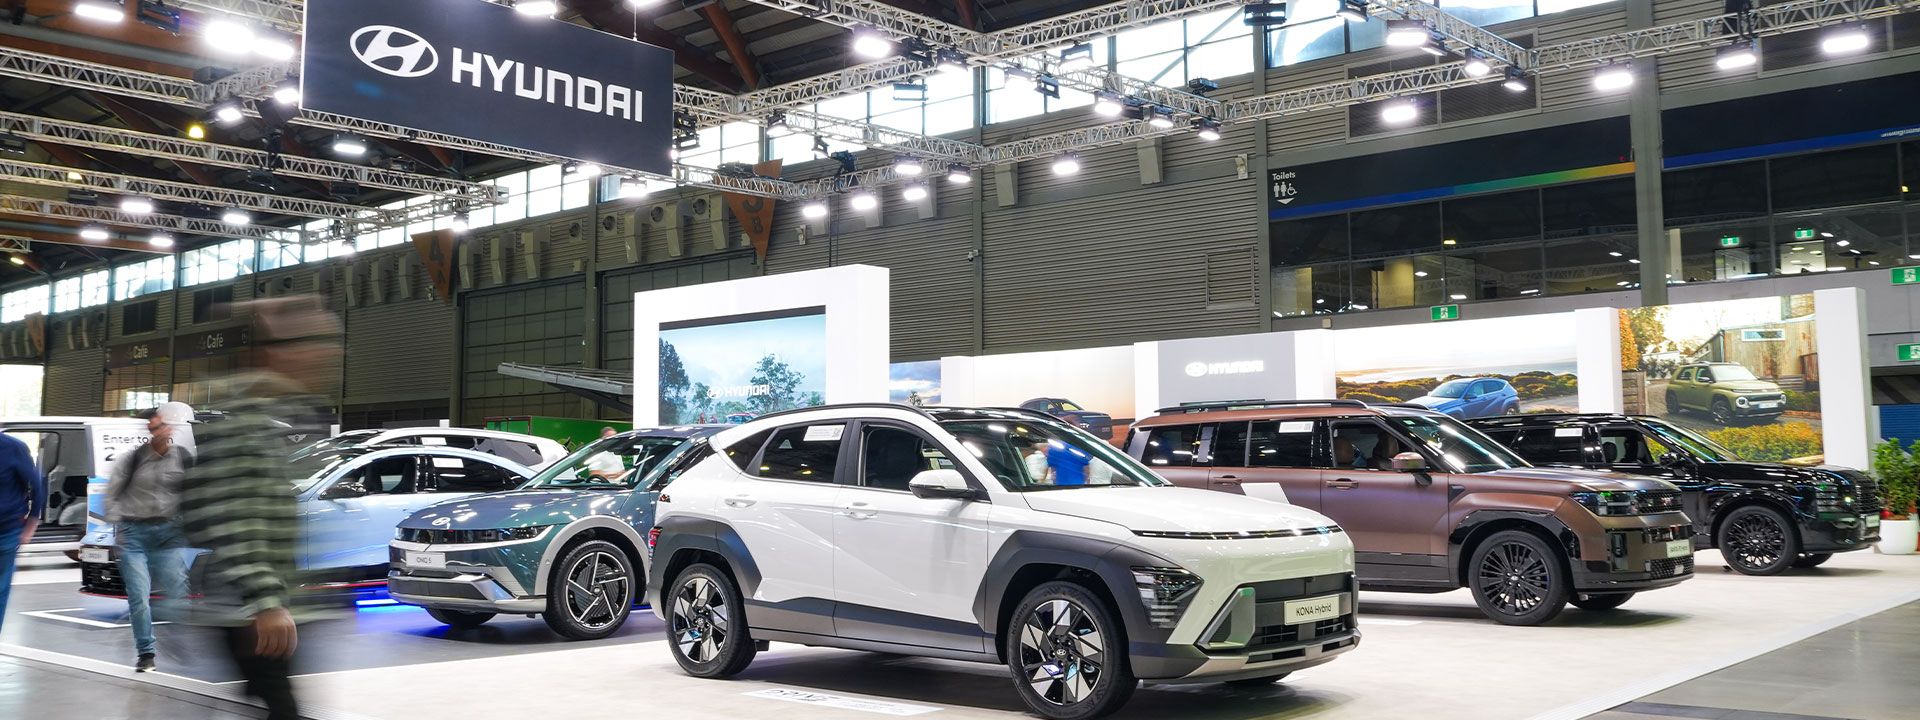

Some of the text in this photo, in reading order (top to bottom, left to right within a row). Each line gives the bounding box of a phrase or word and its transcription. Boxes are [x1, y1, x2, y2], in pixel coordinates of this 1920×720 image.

[452, 47, 642, 122] HYUNDAI
[1272, 171, 1296, 180] Toilets
[206, 334, 224, 349] Café
[133, 345, 149, 359] Café
[1208, 359, 1264, 375] HYUNDAI
[725, 384, 769, 397] HYUNDAI
[103, 434, 134, 444] Enter
[1296, 603, 1332, 616] KONA Hybrid
